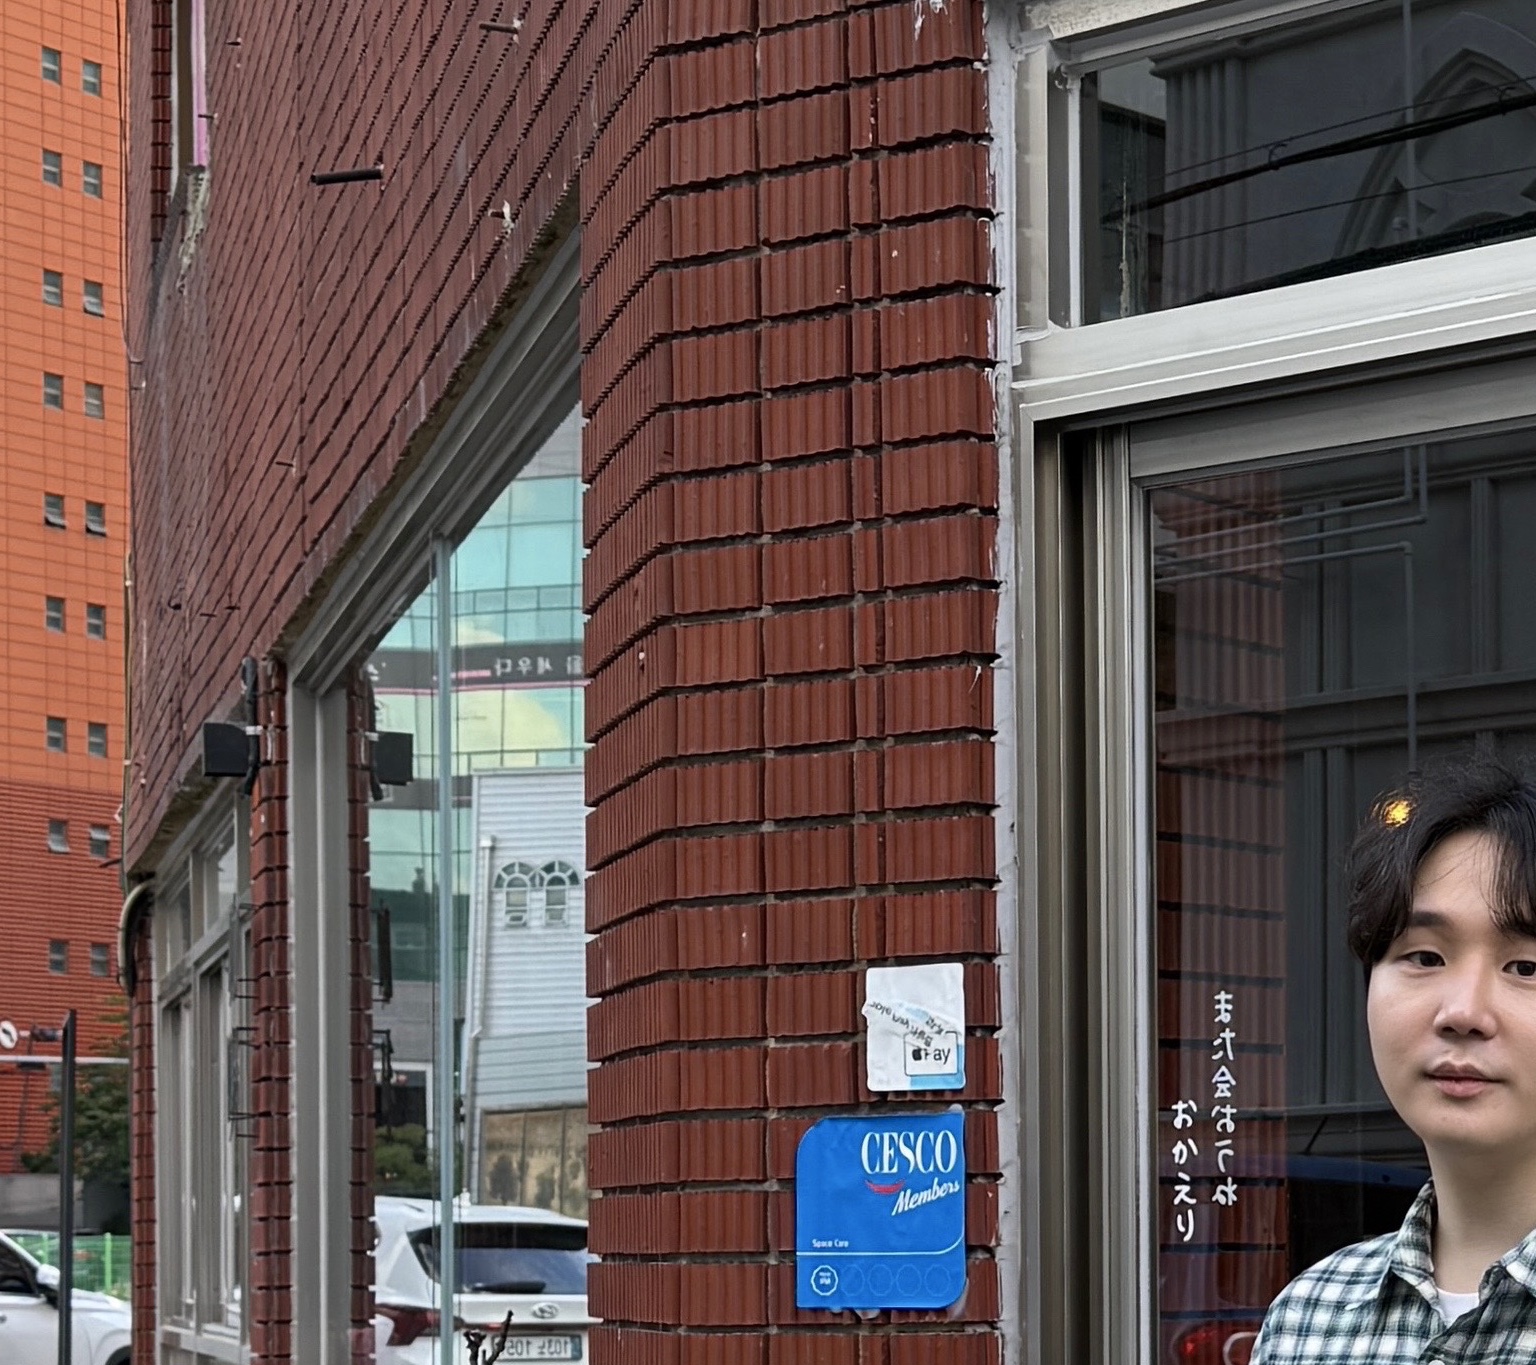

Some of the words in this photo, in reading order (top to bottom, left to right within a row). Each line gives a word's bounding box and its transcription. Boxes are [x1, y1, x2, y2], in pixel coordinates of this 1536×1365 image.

[861, 1129, 958, 1175] CESCO
[1170, 1099, 1199, 1243] おかえり
[891, 1177, 960, 1216] Members
